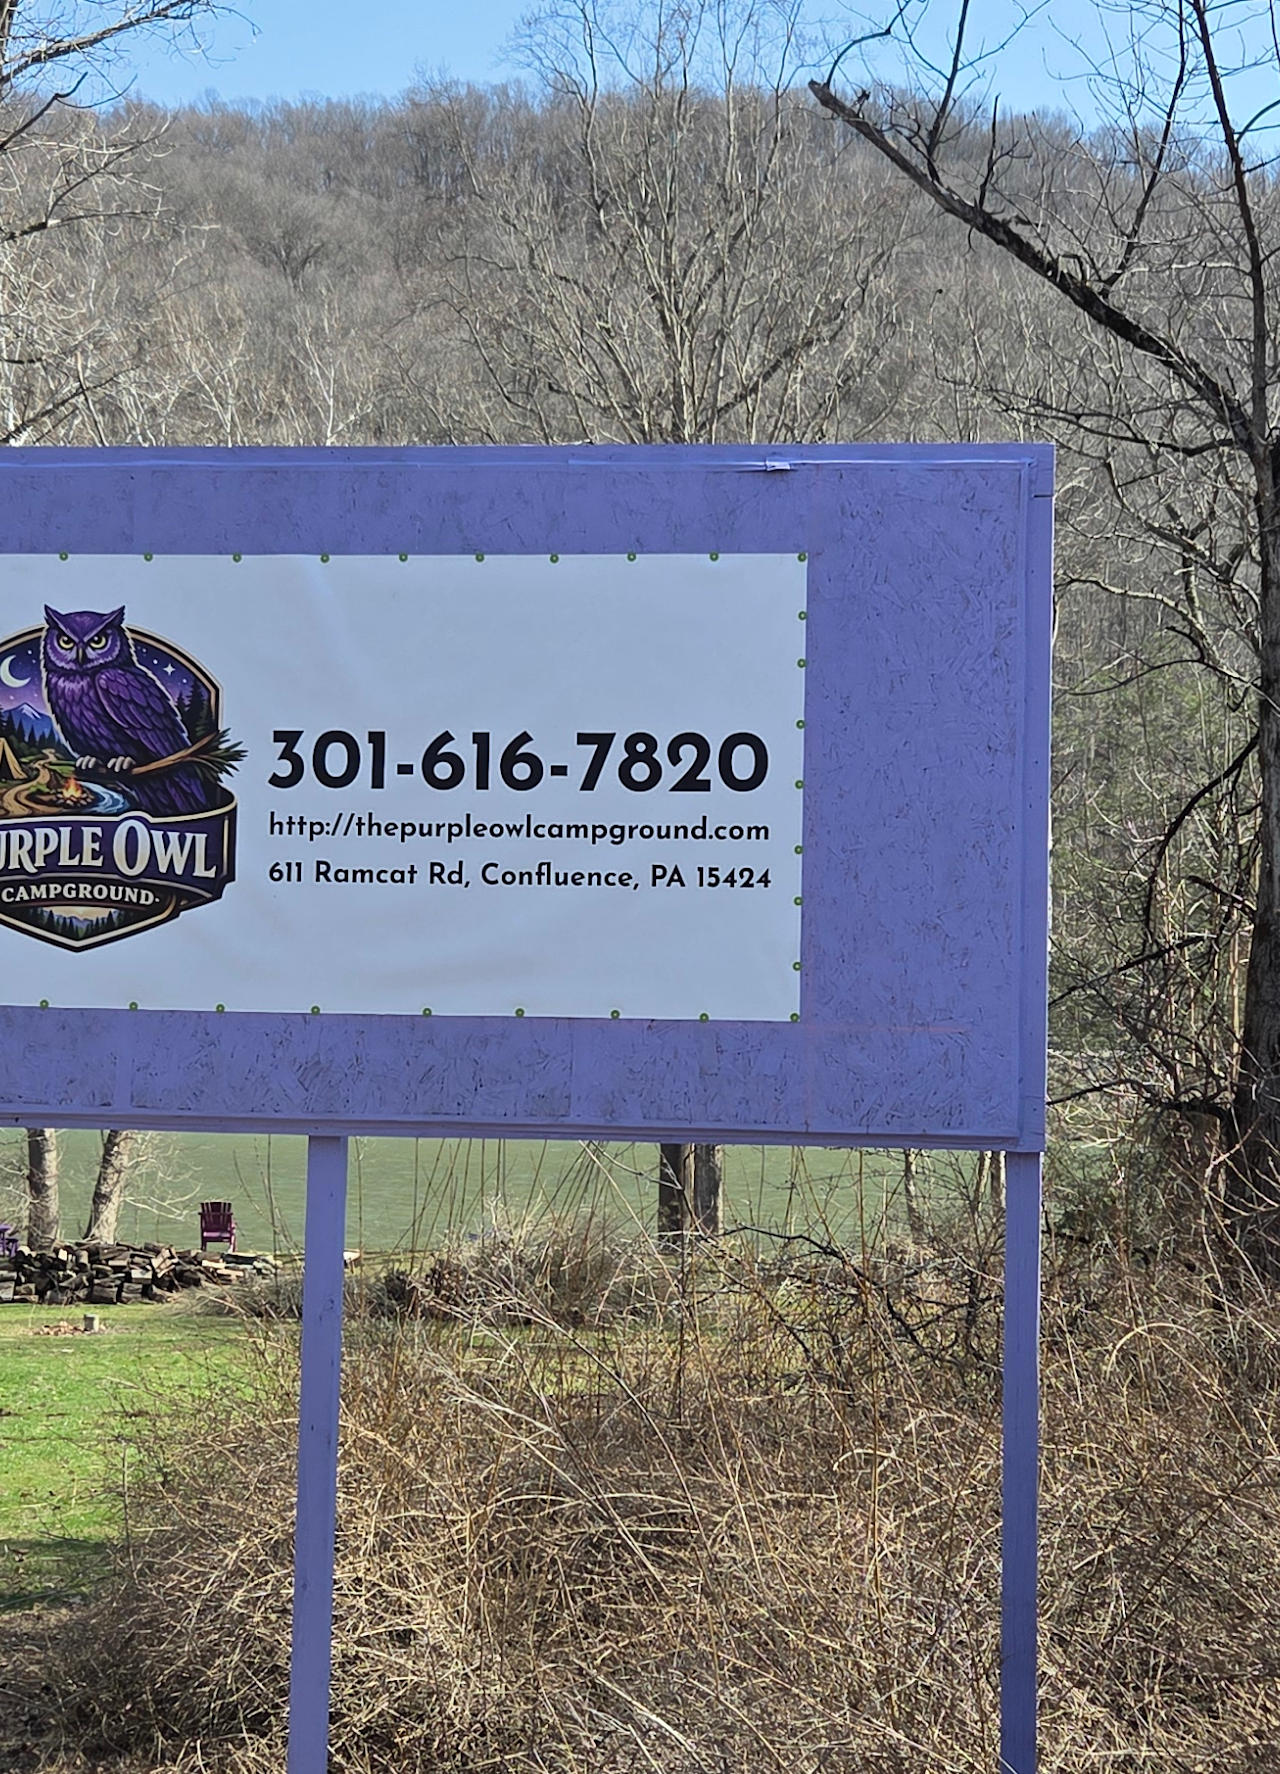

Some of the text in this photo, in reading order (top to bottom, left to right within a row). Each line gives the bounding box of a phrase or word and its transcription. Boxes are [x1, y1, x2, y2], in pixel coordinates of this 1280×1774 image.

[267, 730, 769, 793] 301-616-7820
[269, 810, 769, 846] http://thepurpleowlcampground.com
[113, 819, 217, 880] OWL
[268, 859, 772, 891] 611 Ramcat Rd, Confluence, PA 15424
[1, 883, 153, 905] CAMPGROUND
